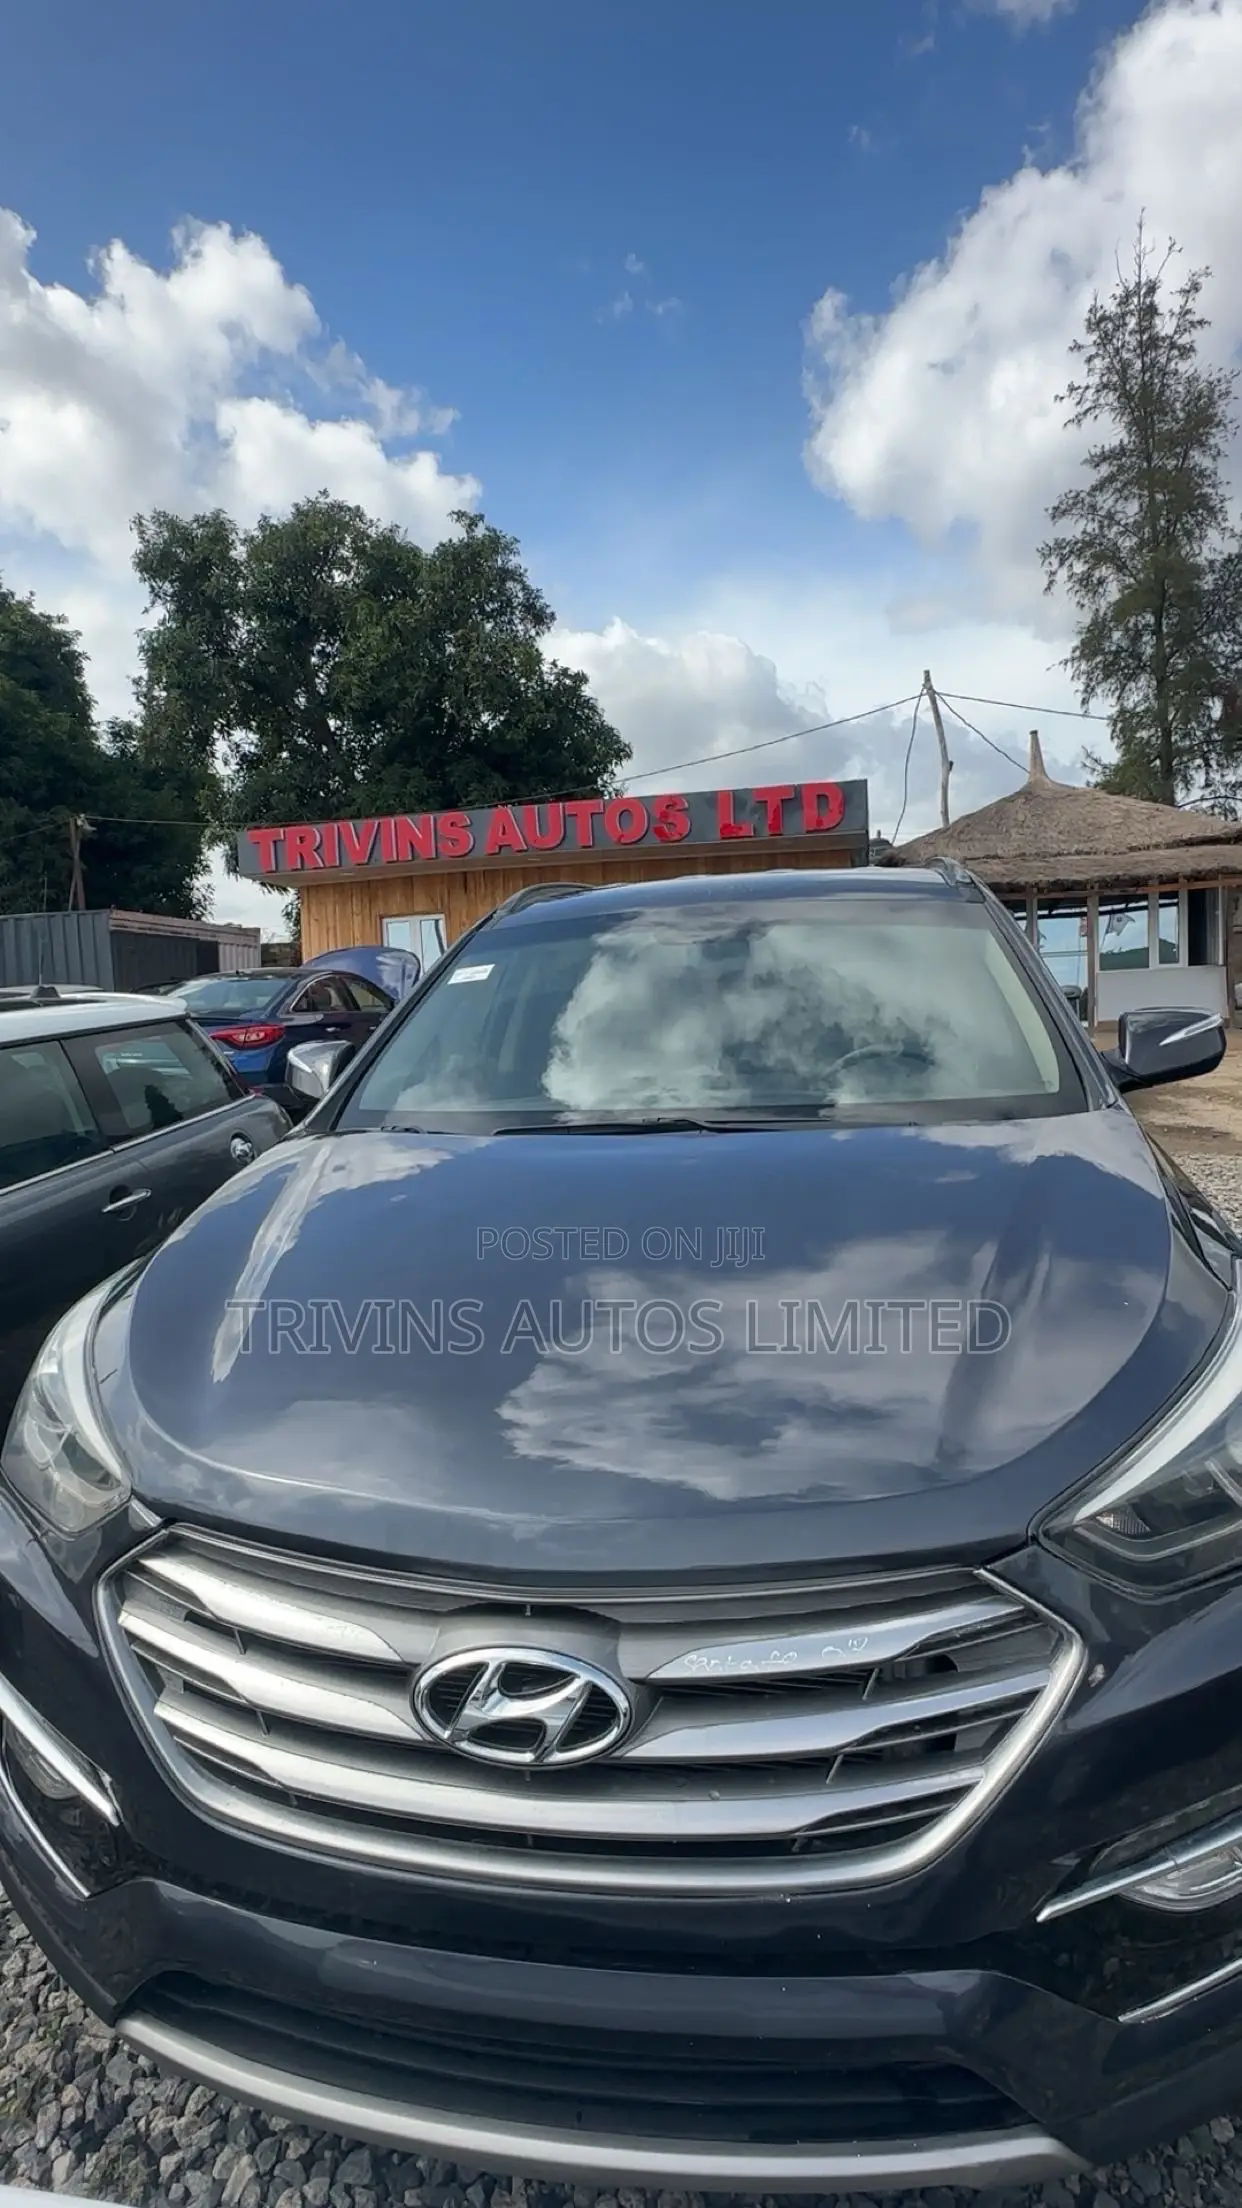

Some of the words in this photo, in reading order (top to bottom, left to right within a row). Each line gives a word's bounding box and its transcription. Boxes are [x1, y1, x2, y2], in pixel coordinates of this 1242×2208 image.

[248, 812, 475, 873] TRIVINS
[484, 793, 692, 855] AUTOS
[718, 782, 846, 840] LTD
